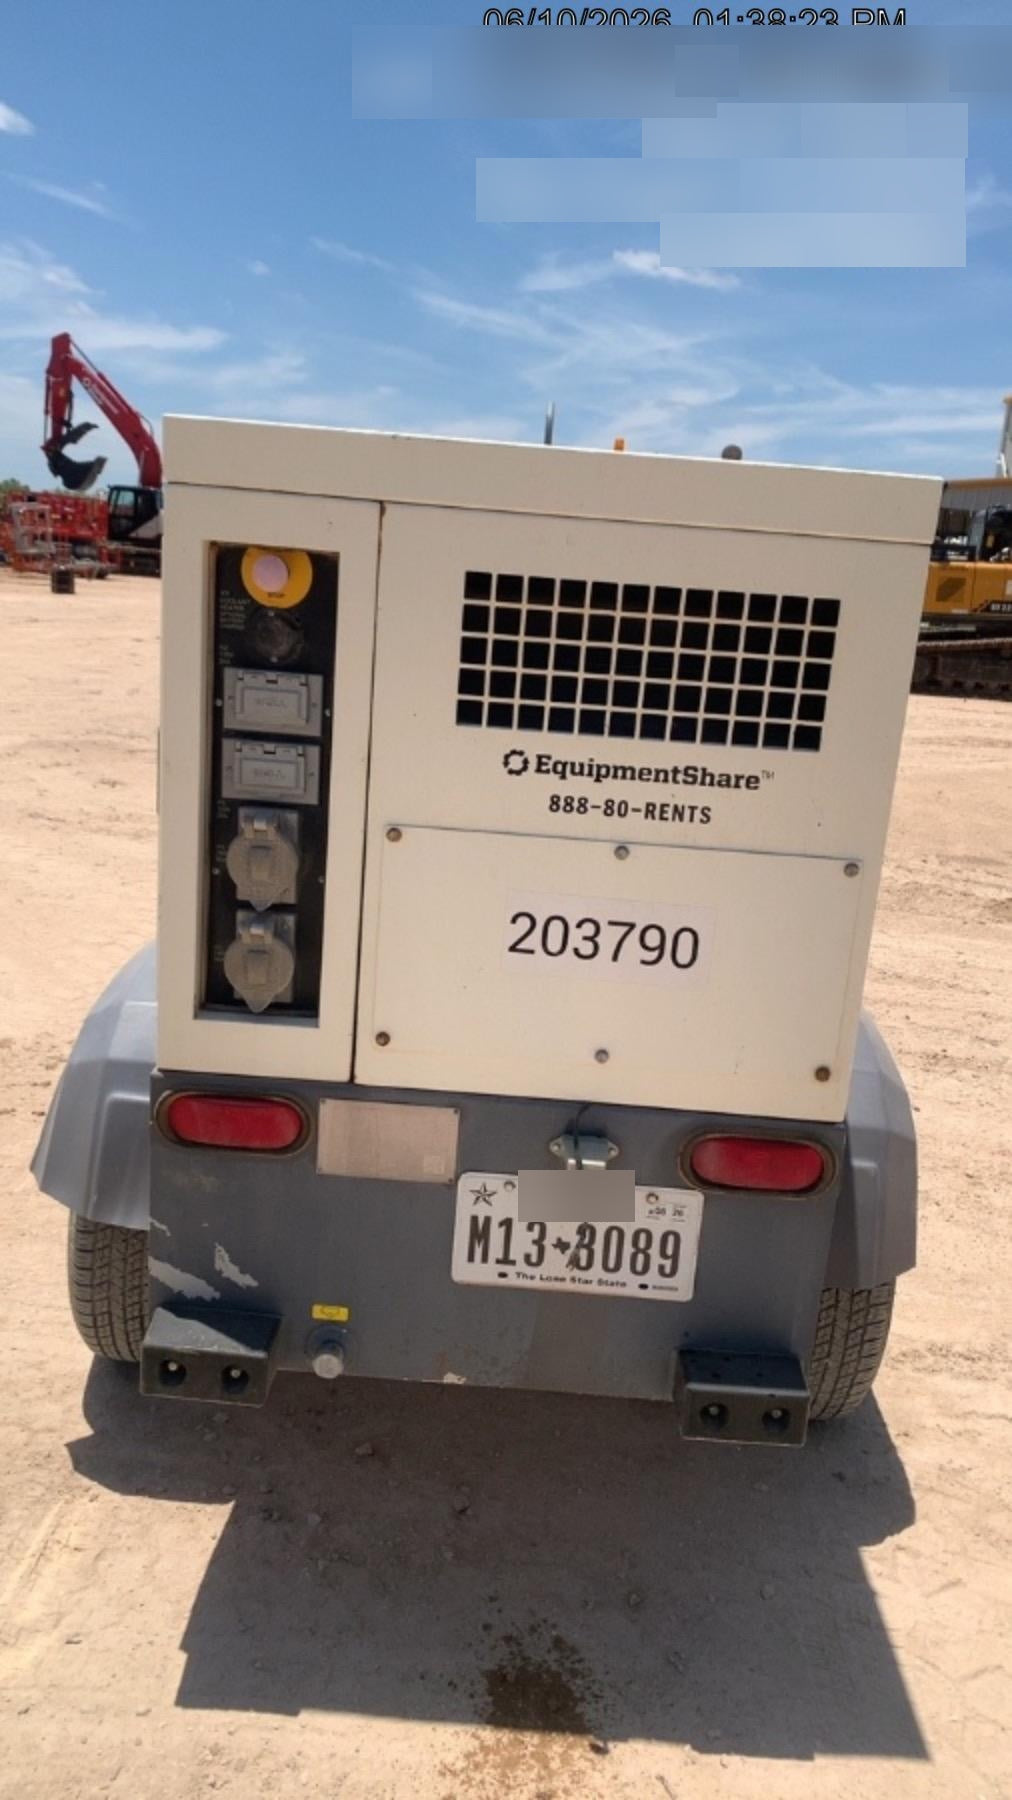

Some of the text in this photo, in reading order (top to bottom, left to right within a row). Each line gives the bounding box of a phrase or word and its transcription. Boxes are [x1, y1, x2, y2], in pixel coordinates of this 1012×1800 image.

[548, 794, 712, 825] 888-80-RENTS
[507, 911, 700, 970] 203790
[466, 1214, 547, 1267] M13
[515, 1271, 627, 1288] The Lone Star State
